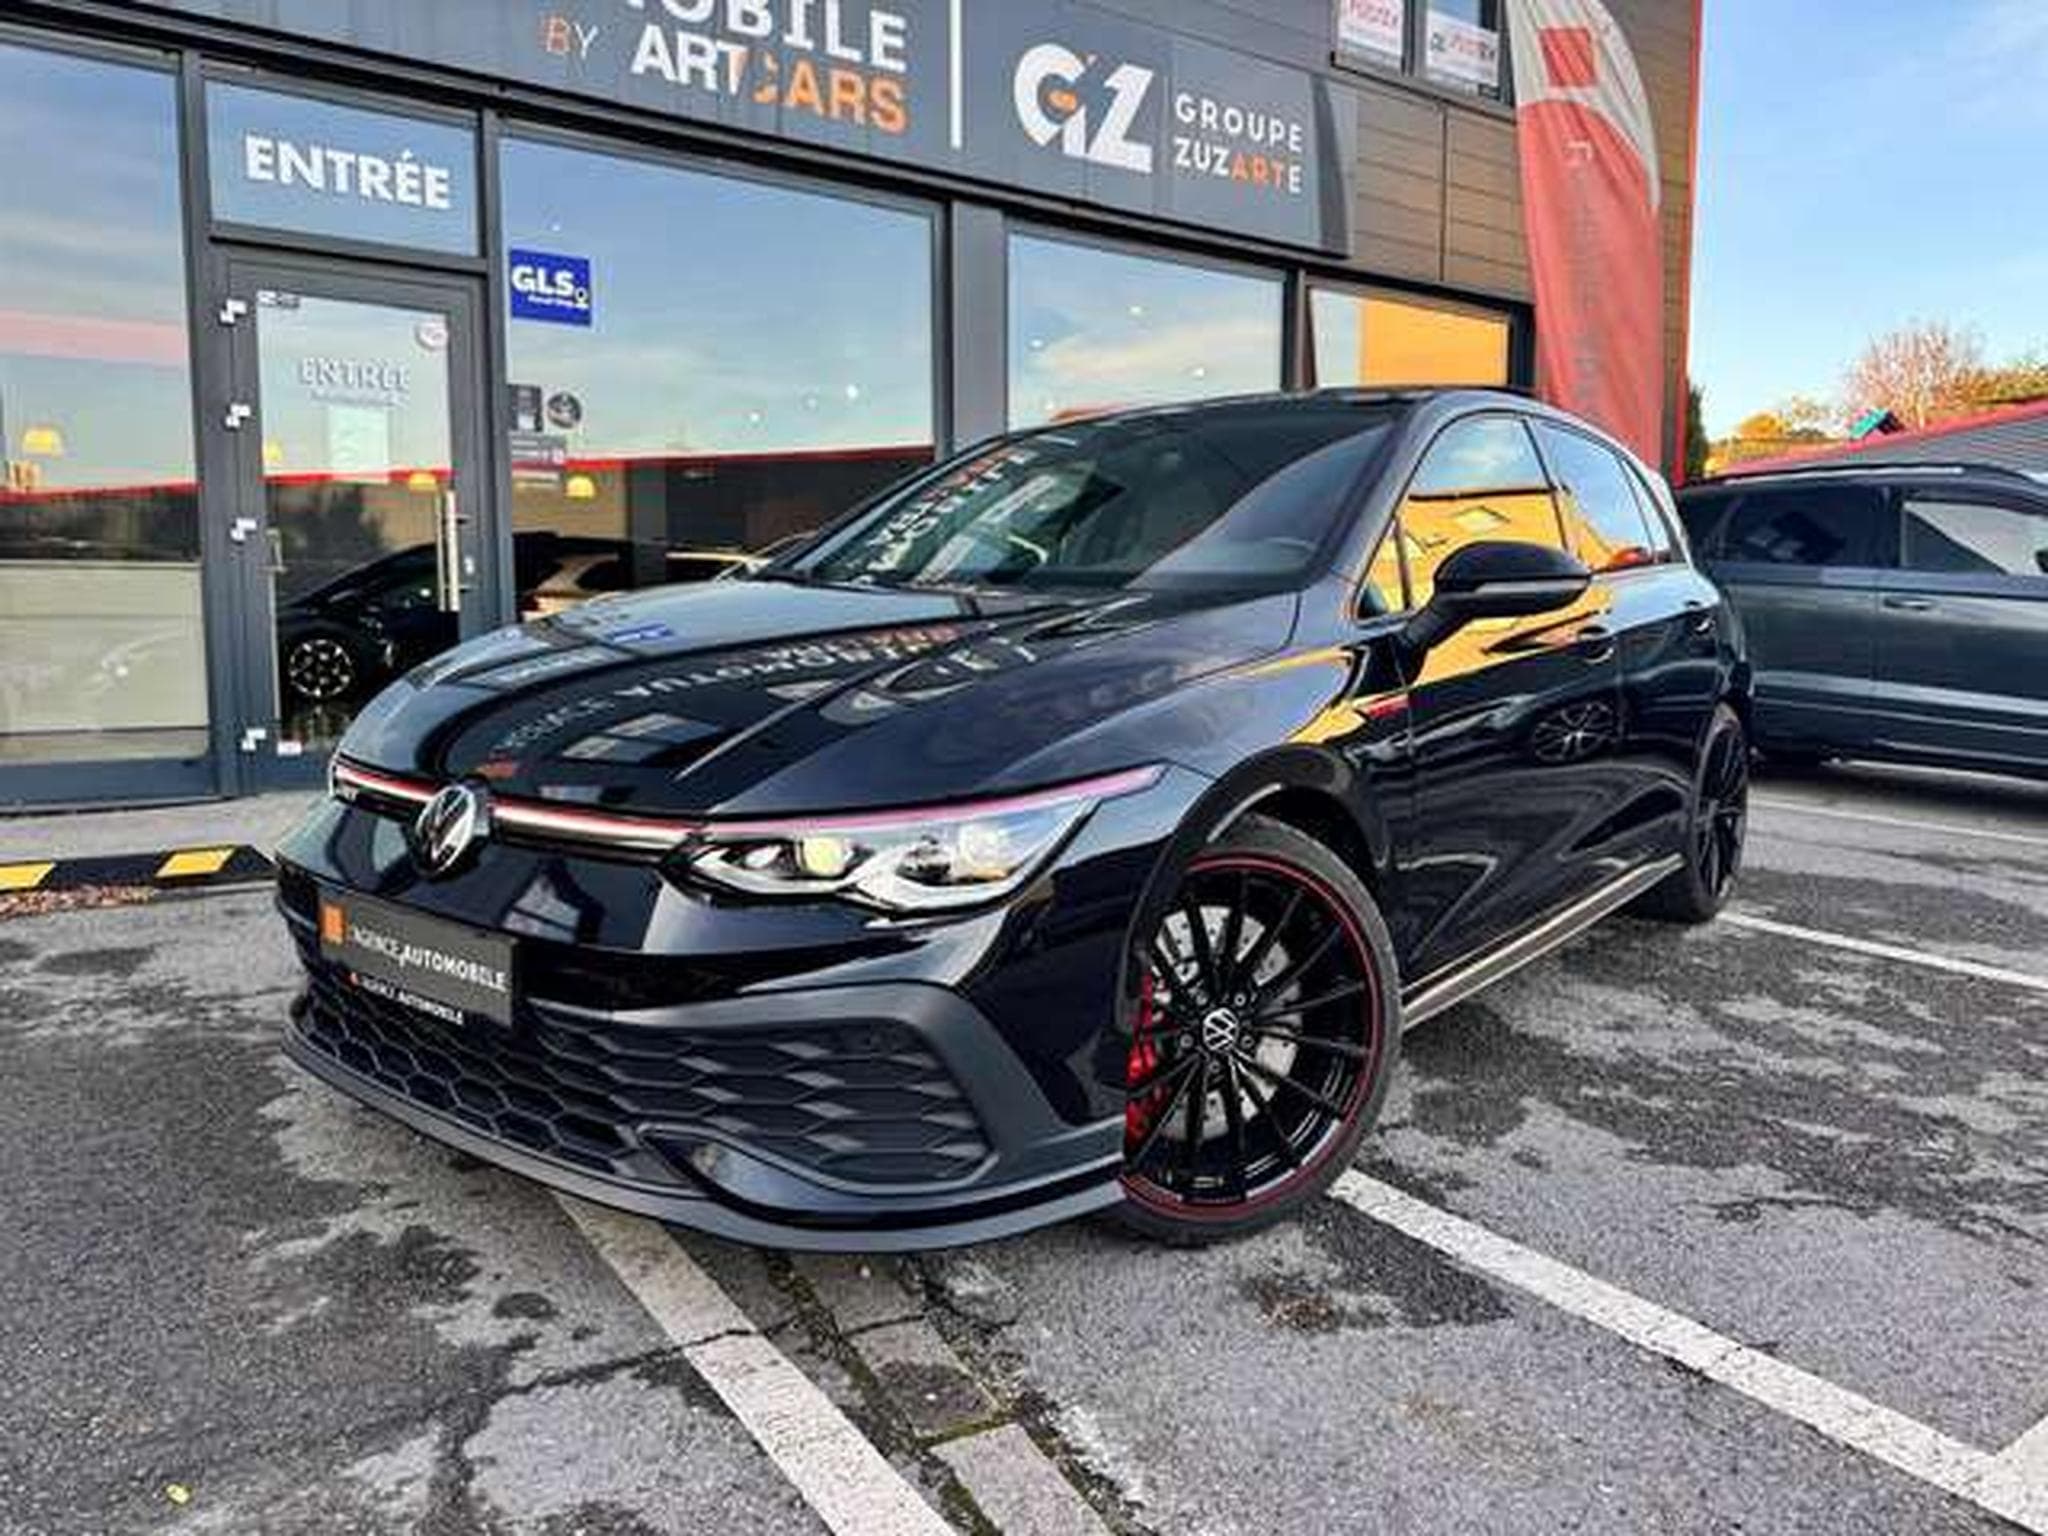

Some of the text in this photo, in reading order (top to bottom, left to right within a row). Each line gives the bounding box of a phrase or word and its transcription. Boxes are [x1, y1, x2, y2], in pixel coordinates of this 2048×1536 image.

[542, 14, 599, 60] BY
[627, 0, 907, 73] BILE
[1174, 93, 1304, 153] GROUPE
[245, 134, 450, 209] ENTRÉE
[1172, 137, 1303, 194] ZUZARTE
[512, 265, 575, 296] GLS
